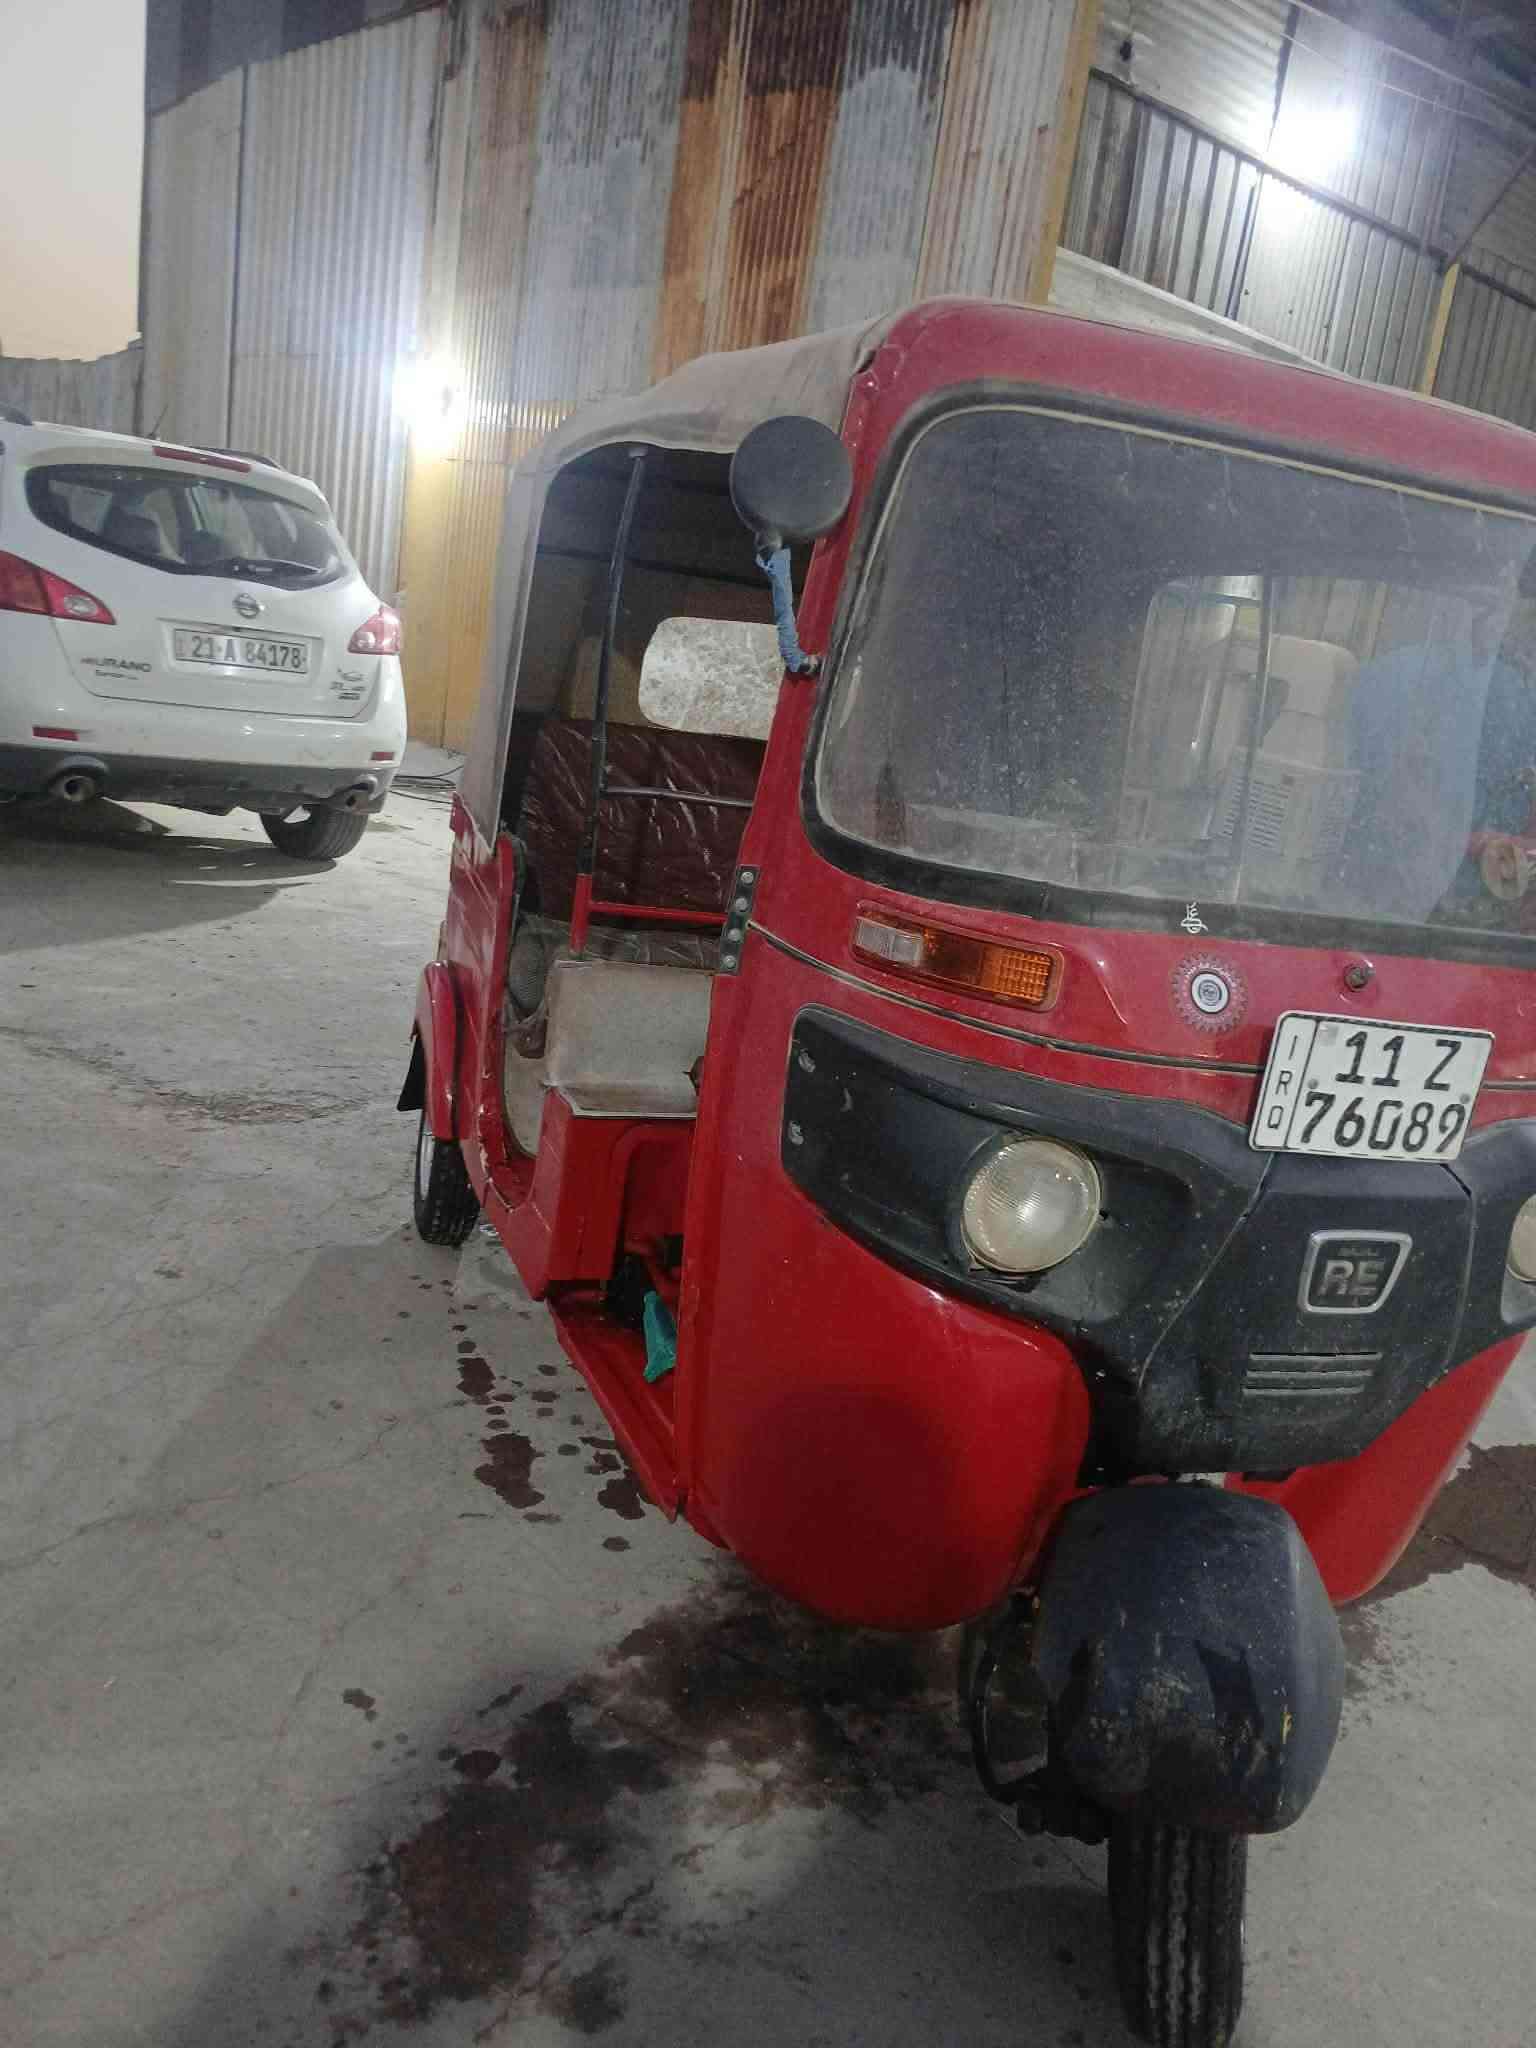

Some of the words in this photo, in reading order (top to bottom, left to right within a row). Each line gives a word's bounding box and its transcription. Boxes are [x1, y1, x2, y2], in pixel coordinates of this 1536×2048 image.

[191, 635, 215, 659] 21
[223, 638, 236, 662] A
[1267, 1034, 1298, 1130] IRQ
[1335, 1030, 1405, 1087] 11
[1423, 1038, 1462, 1092] Z
[1300, 1091, 1466, 1153] 76089
[1317, 1259, 1384, 1296] RE
